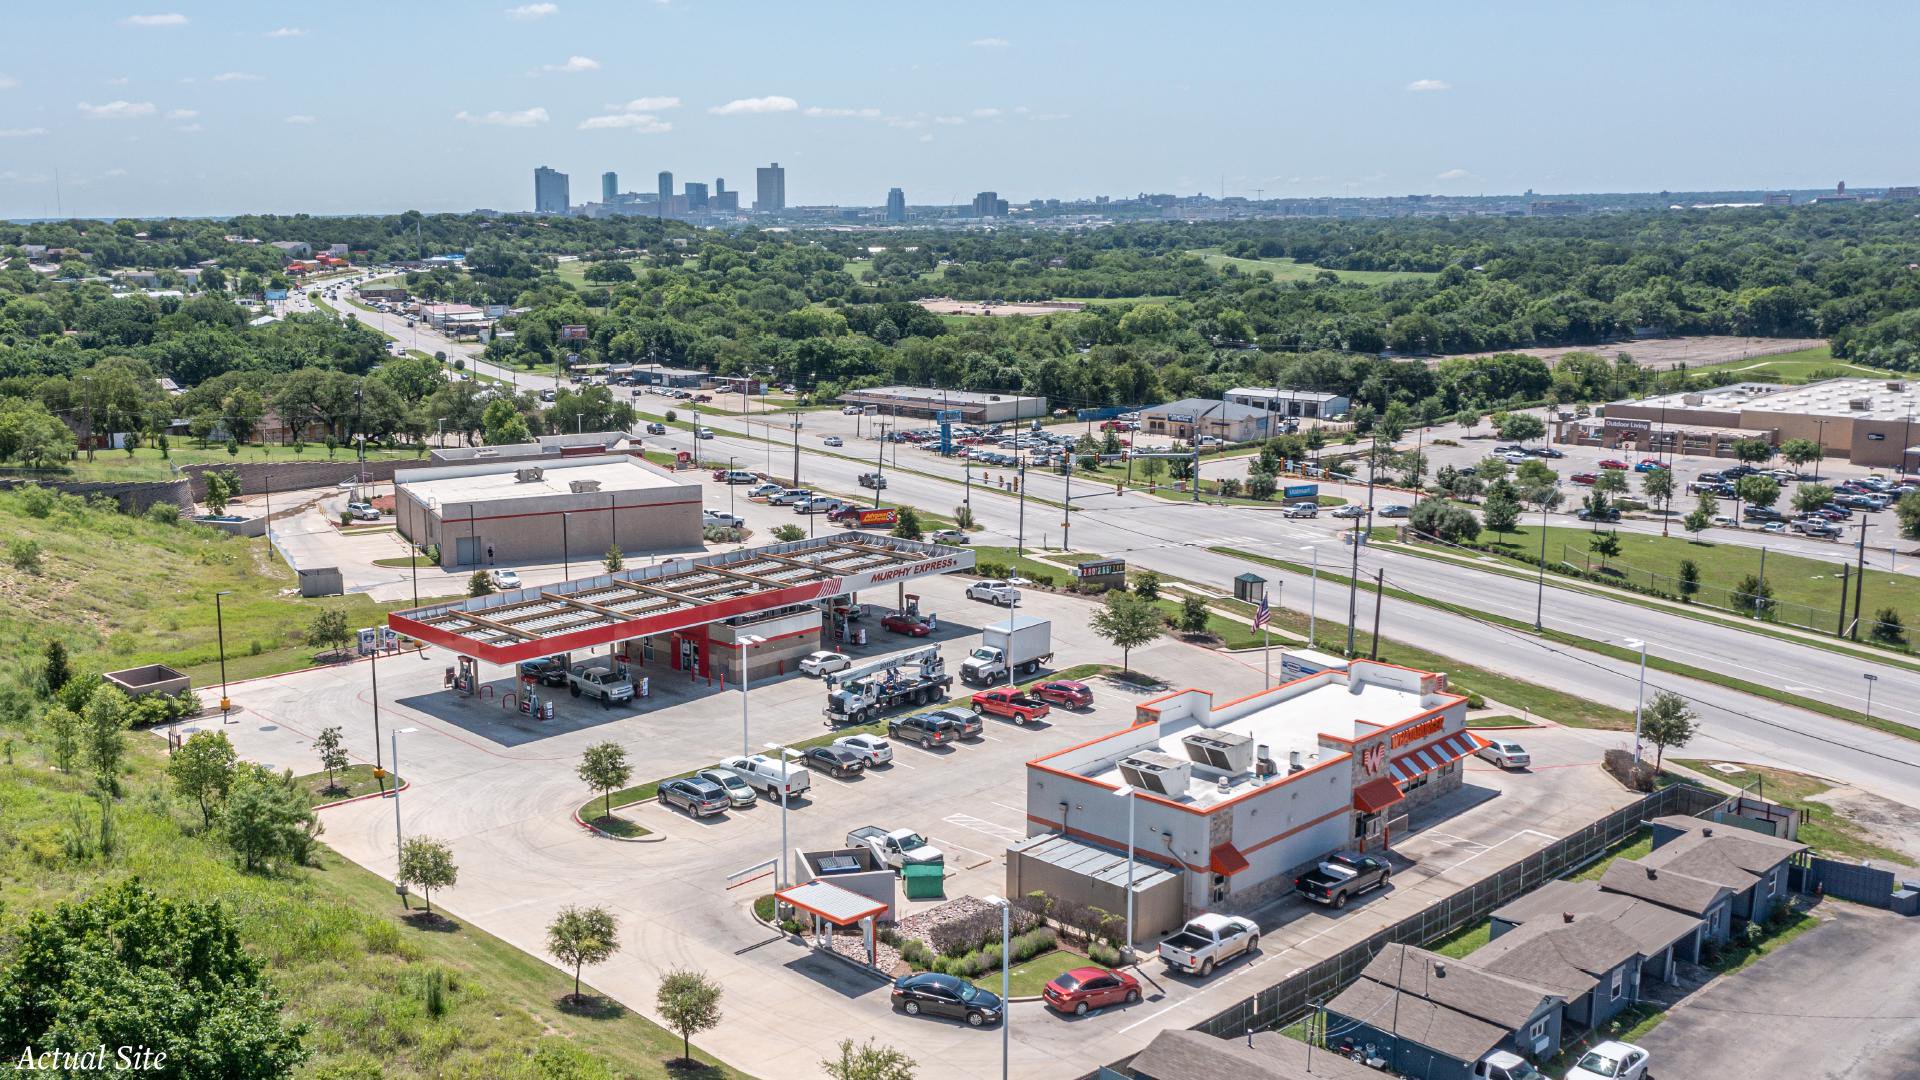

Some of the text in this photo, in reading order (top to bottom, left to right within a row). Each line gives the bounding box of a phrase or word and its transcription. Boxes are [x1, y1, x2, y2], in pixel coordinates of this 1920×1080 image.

[1606, 420, 1648, 430] Outdoor Living
[870, 558, 953, 583] MURPHY EXPRESS
